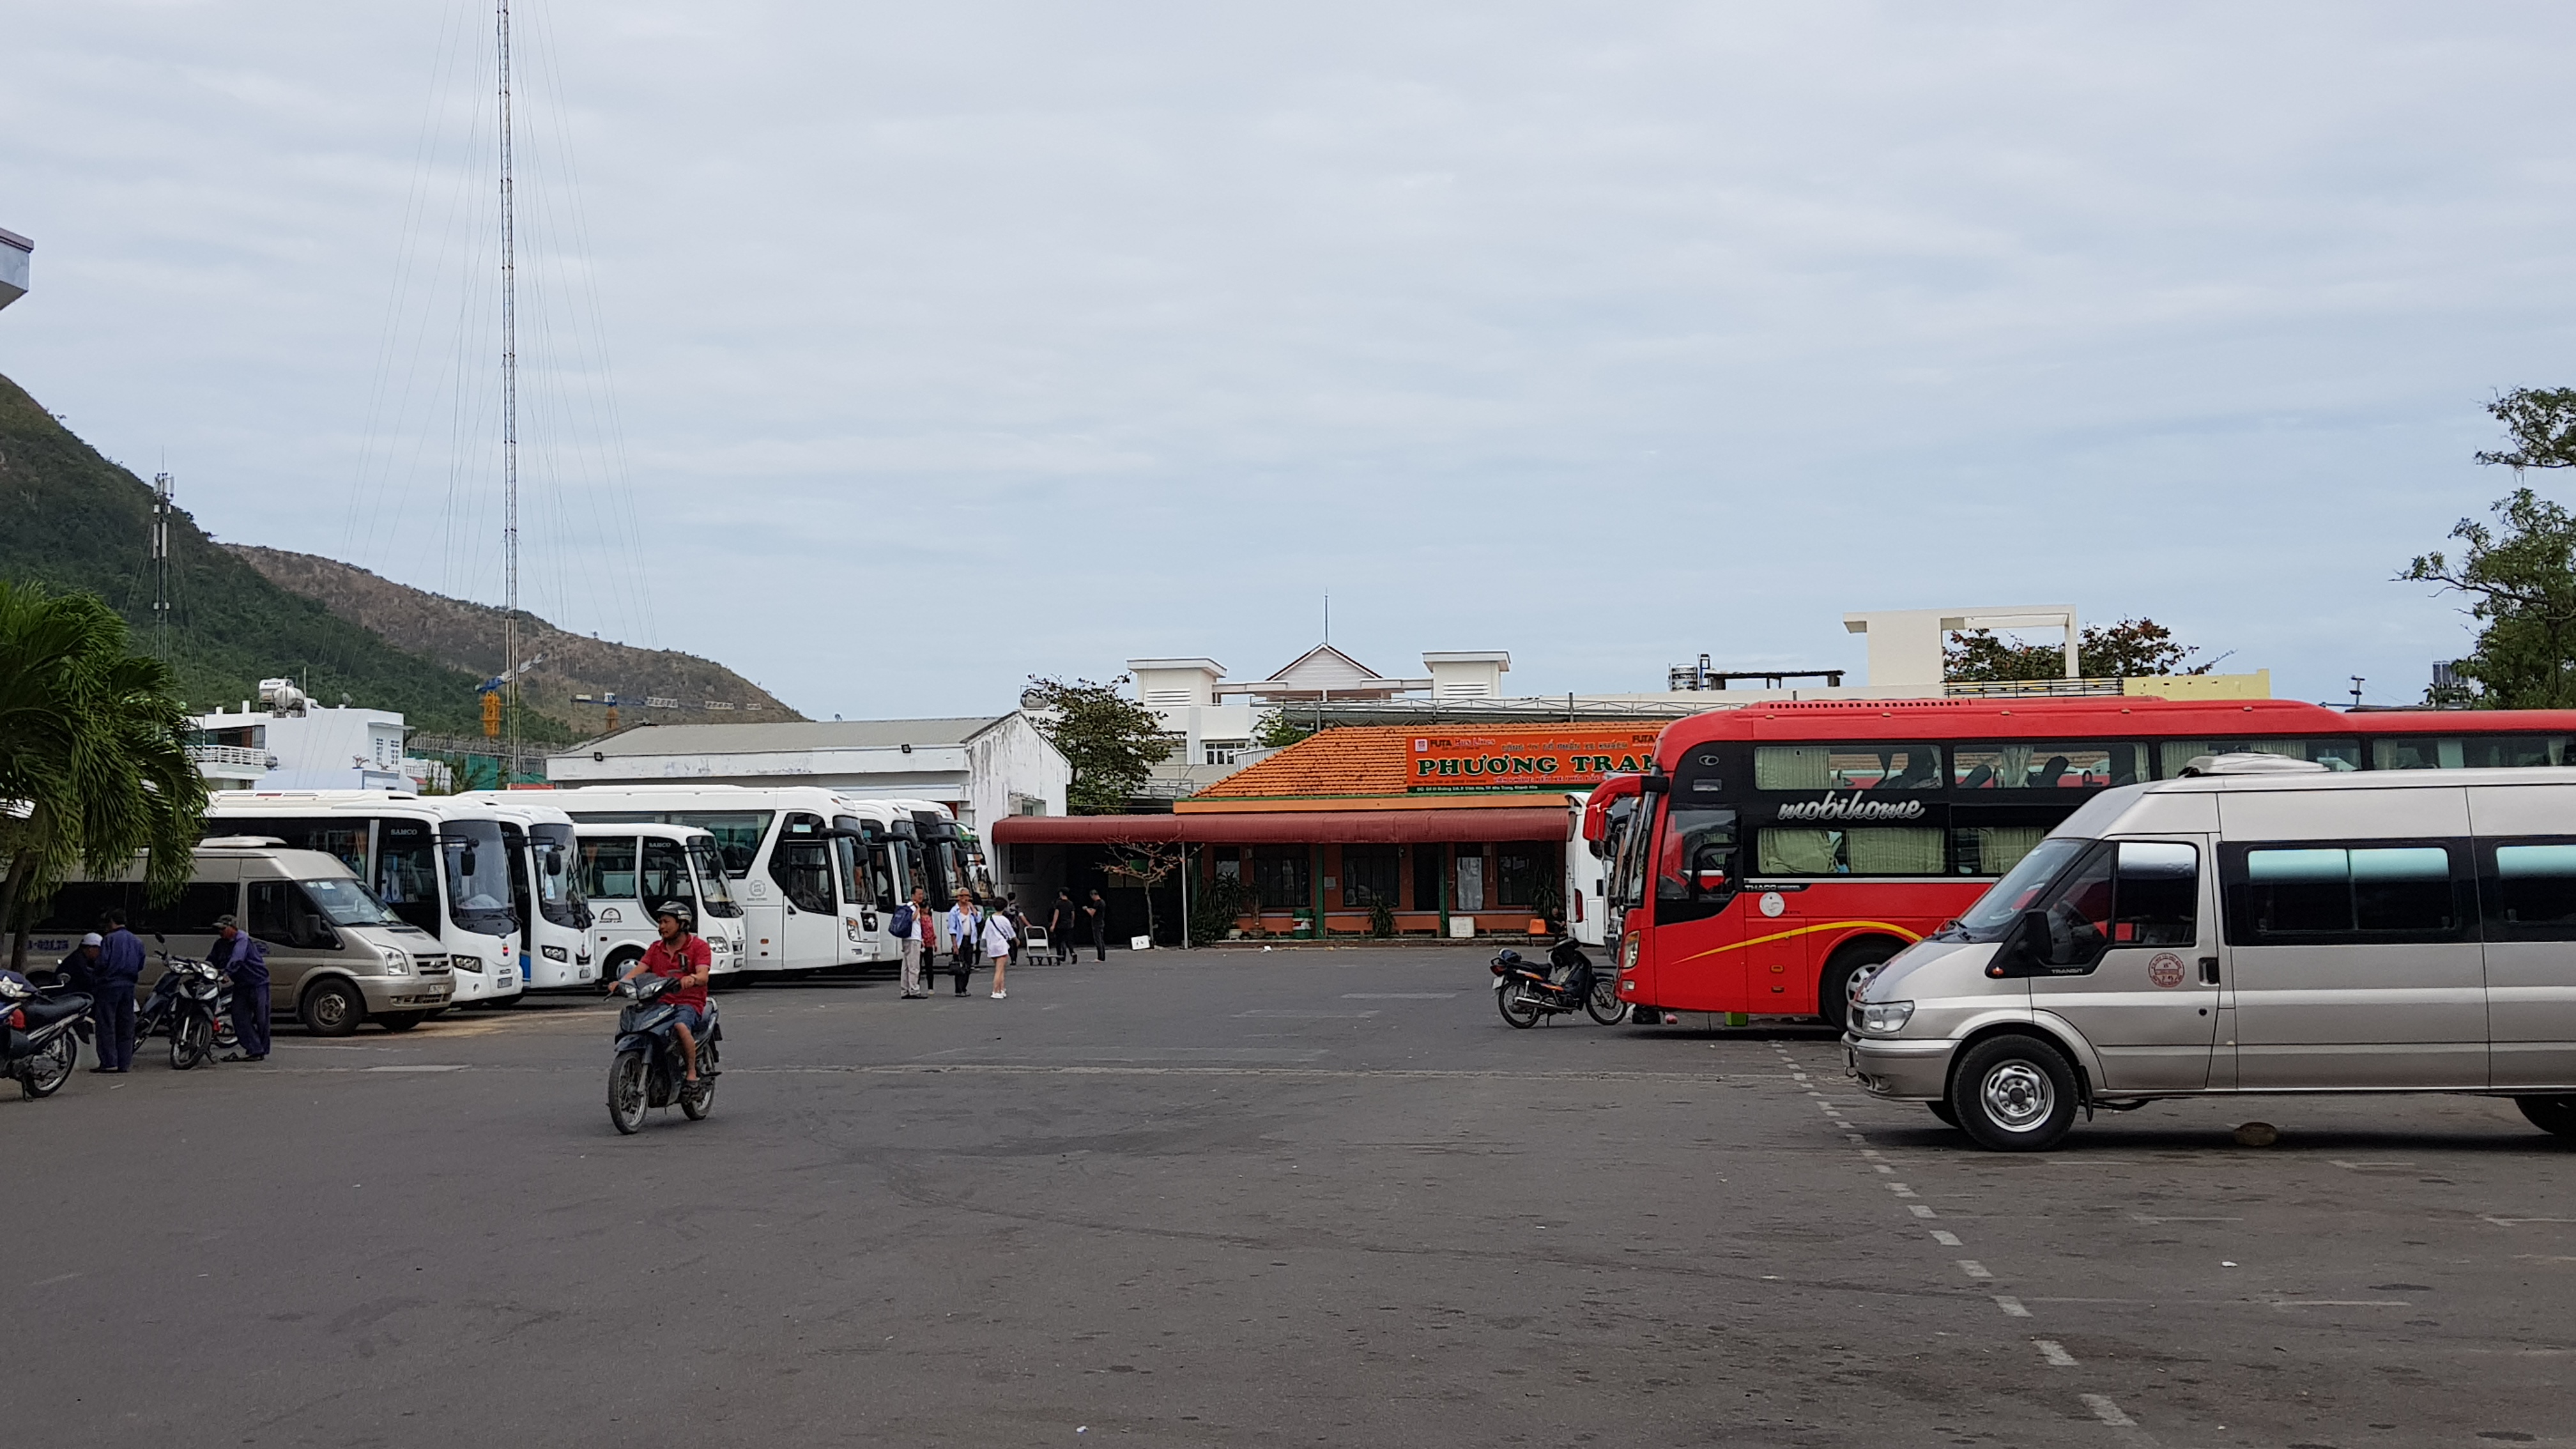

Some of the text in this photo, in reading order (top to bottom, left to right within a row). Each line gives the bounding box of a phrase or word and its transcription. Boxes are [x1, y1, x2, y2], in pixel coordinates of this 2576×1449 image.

[1455, 738, 1472, 746] Bus
[1473, 737, 1496, 746] Lines
[1632, 735, 1655, 743] FUTA
[1415, 753, 1560, 776] PHƯƠNG
[1777, 790, 1926, 820] mobihome
